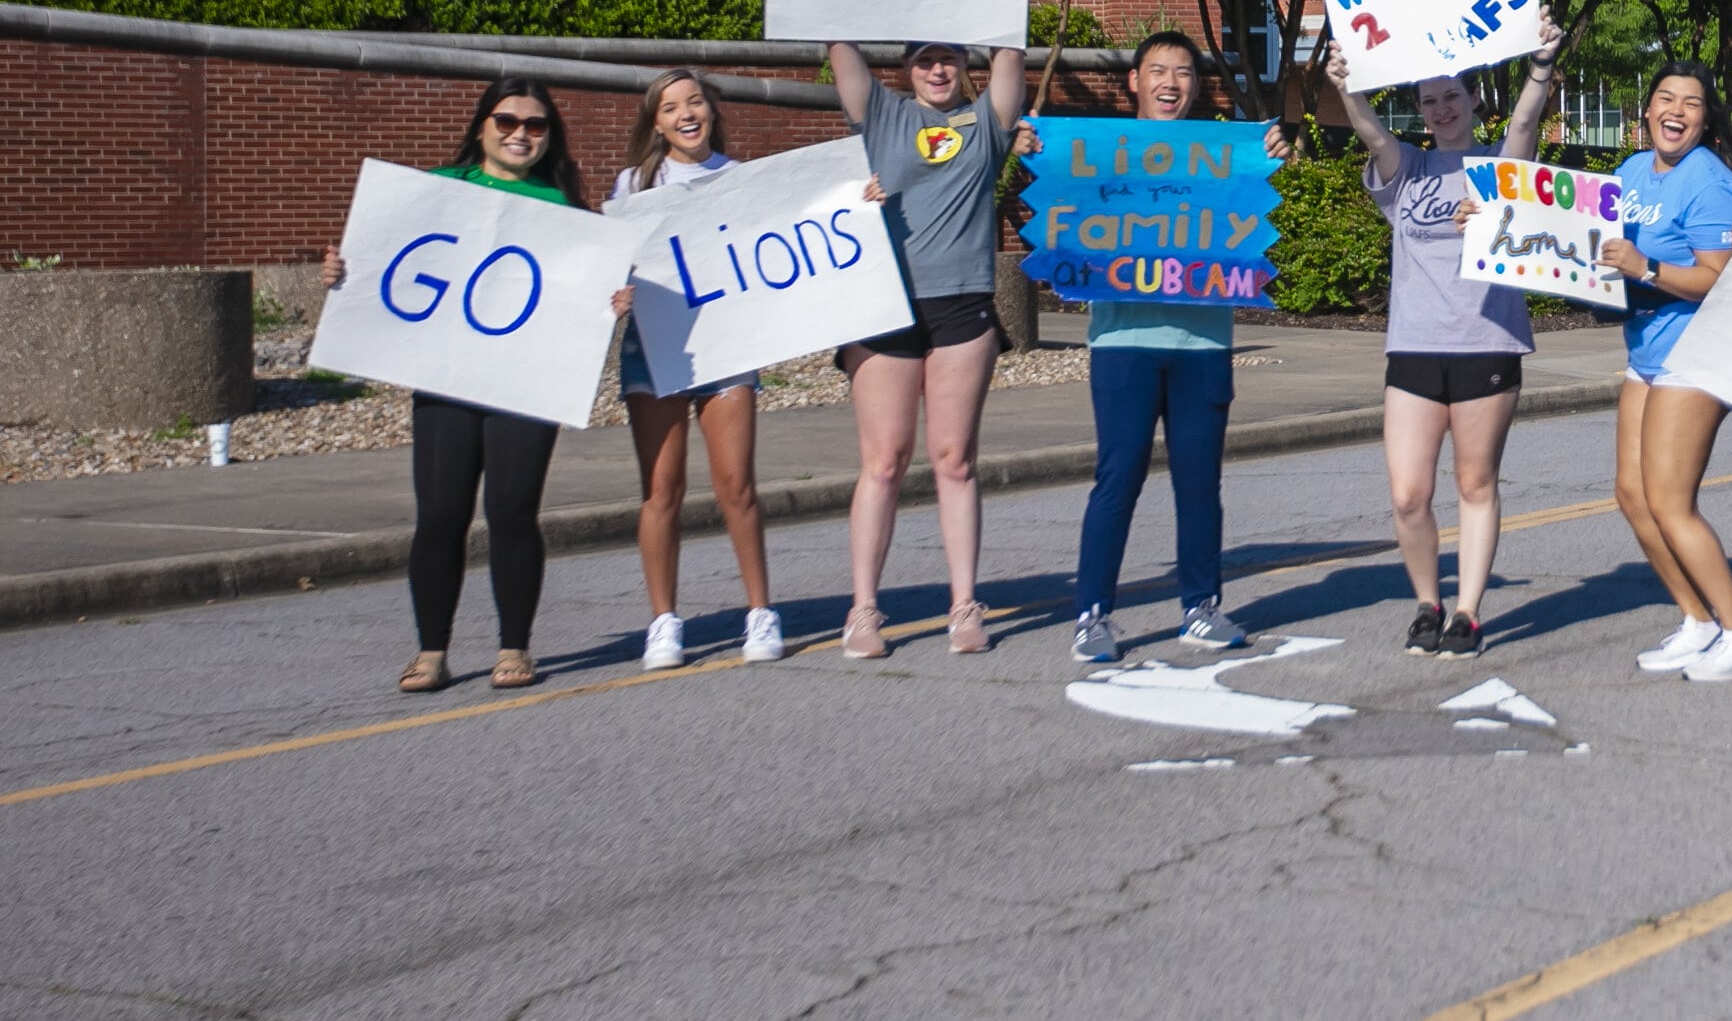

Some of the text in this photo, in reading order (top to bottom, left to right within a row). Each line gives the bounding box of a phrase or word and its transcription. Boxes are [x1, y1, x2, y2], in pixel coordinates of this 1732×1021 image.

[1351, 12, 1390, 51] 2
[1466, 161, 1622, 222] WELCOME
[1622, 188, 1663, 226] ions
[379, 232, 543, 336] GO
[669, 208, 862, 314] Lions
